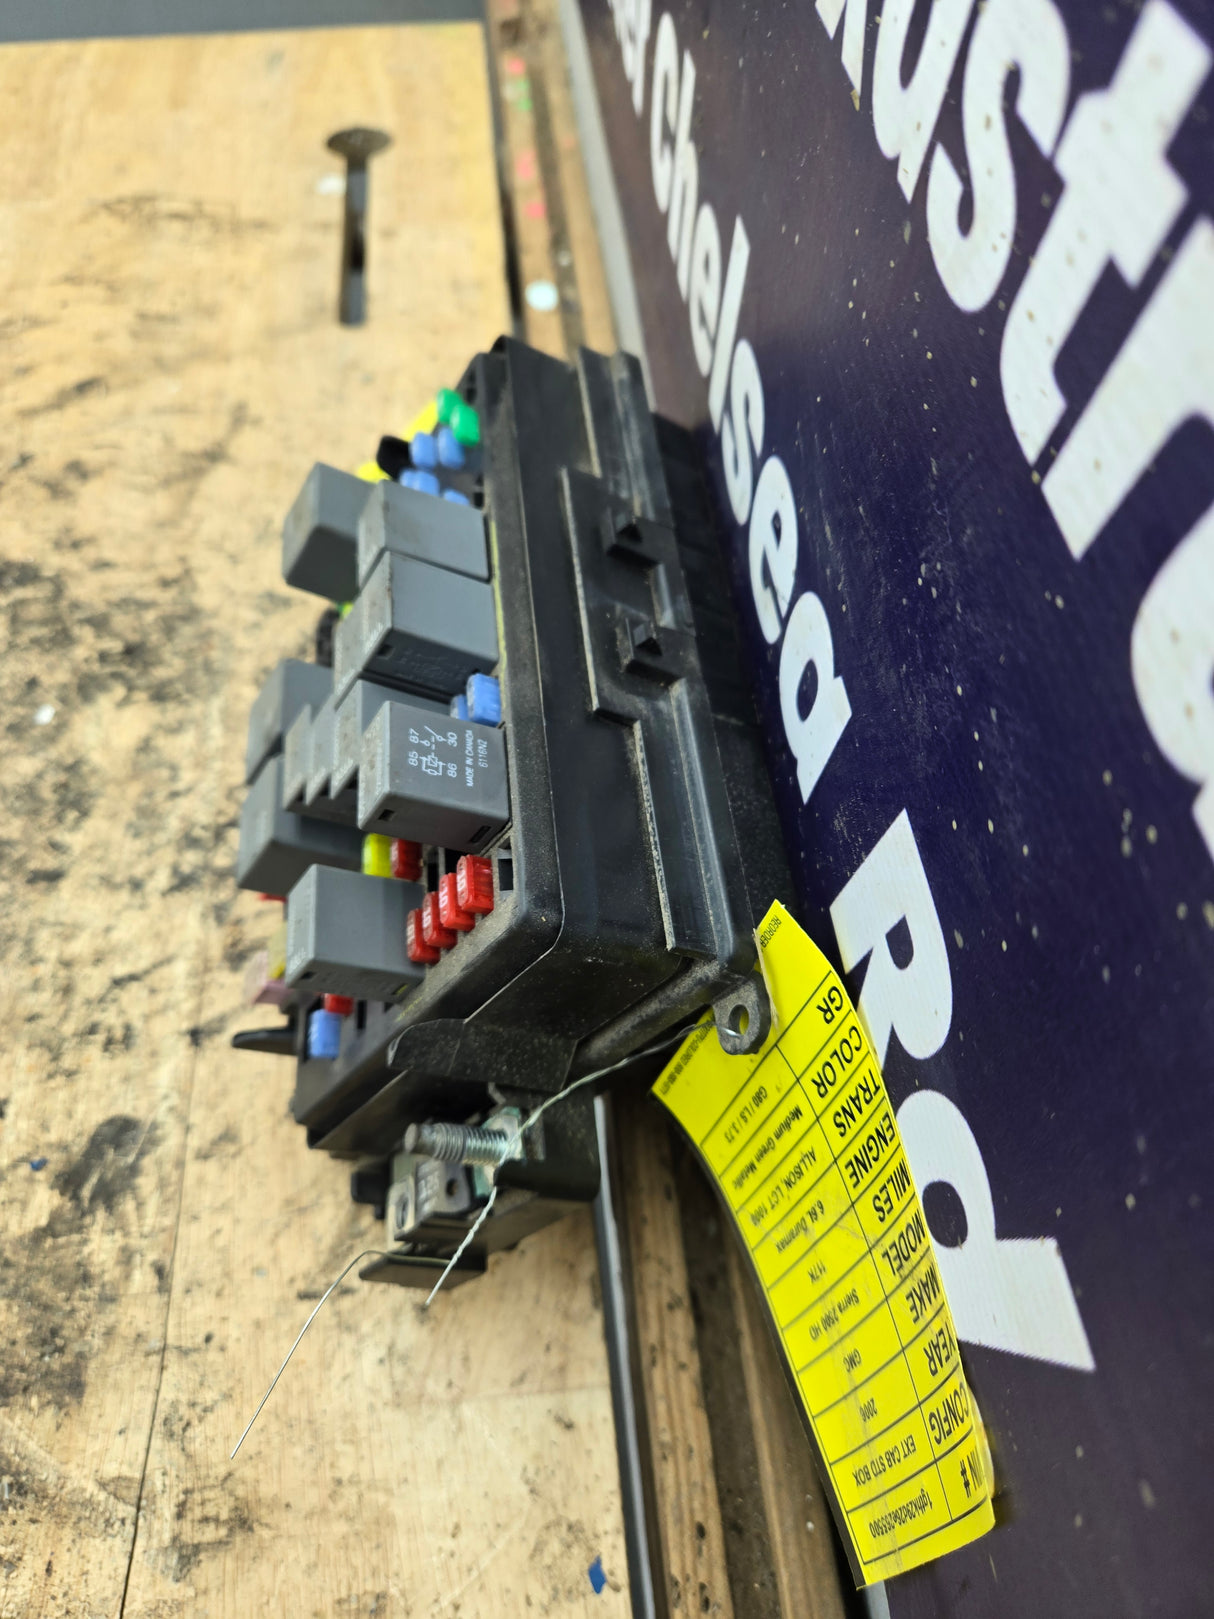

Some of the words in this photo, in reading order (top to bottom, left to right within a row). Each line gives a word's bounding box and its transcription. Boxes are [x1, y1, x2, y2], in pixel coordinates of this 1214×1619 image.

[408, 728, 420, 744] 87
[446, 732, 458, 747] 30
[466, 729, 475, 757] CANADA
[408, 751, 420, 767] 85
[447, 763, 458, 778] 86
[466, 757, 475, 769] IN
[466, 769, 475, 787] MADE
[816, 985, 844, 1025] GR
[811, 1025, 863, 1099] COLOR
[752, 1085, 768, 1107] G80
[833, 1069, 881, 1138] TRANS
[739, 1106, 752, 1124] LS
[773, 1104, 803, 1140] Medium
[754, 1136, 776, 1163] Green
[844, 1111, 896, 1189] ENGINE
[768, 1185, 785, 1210] LCT
[872, 1157, 912, 1223] MILES
[776, 1215, 808, 1253] Duramax
[881, 1208, 927, 1277] MODEL
[836, 1287, 860, 1314] Sierra
[905, 1276, 941, 1325] MAKE
[808, 1321, 822, 1341] HD
[843, 1348, 863, 1373] GMC
[923, 1324, 957, 1377] YEAR
[928, 1381, 969, 1446] CONFIG
[885, 1445, 902, 1469] CAB
[901, 1434, 917, 1458] EXT
[852, 1463, 872, 1487] BOX
[870, 1455, 887, 1477] STD
